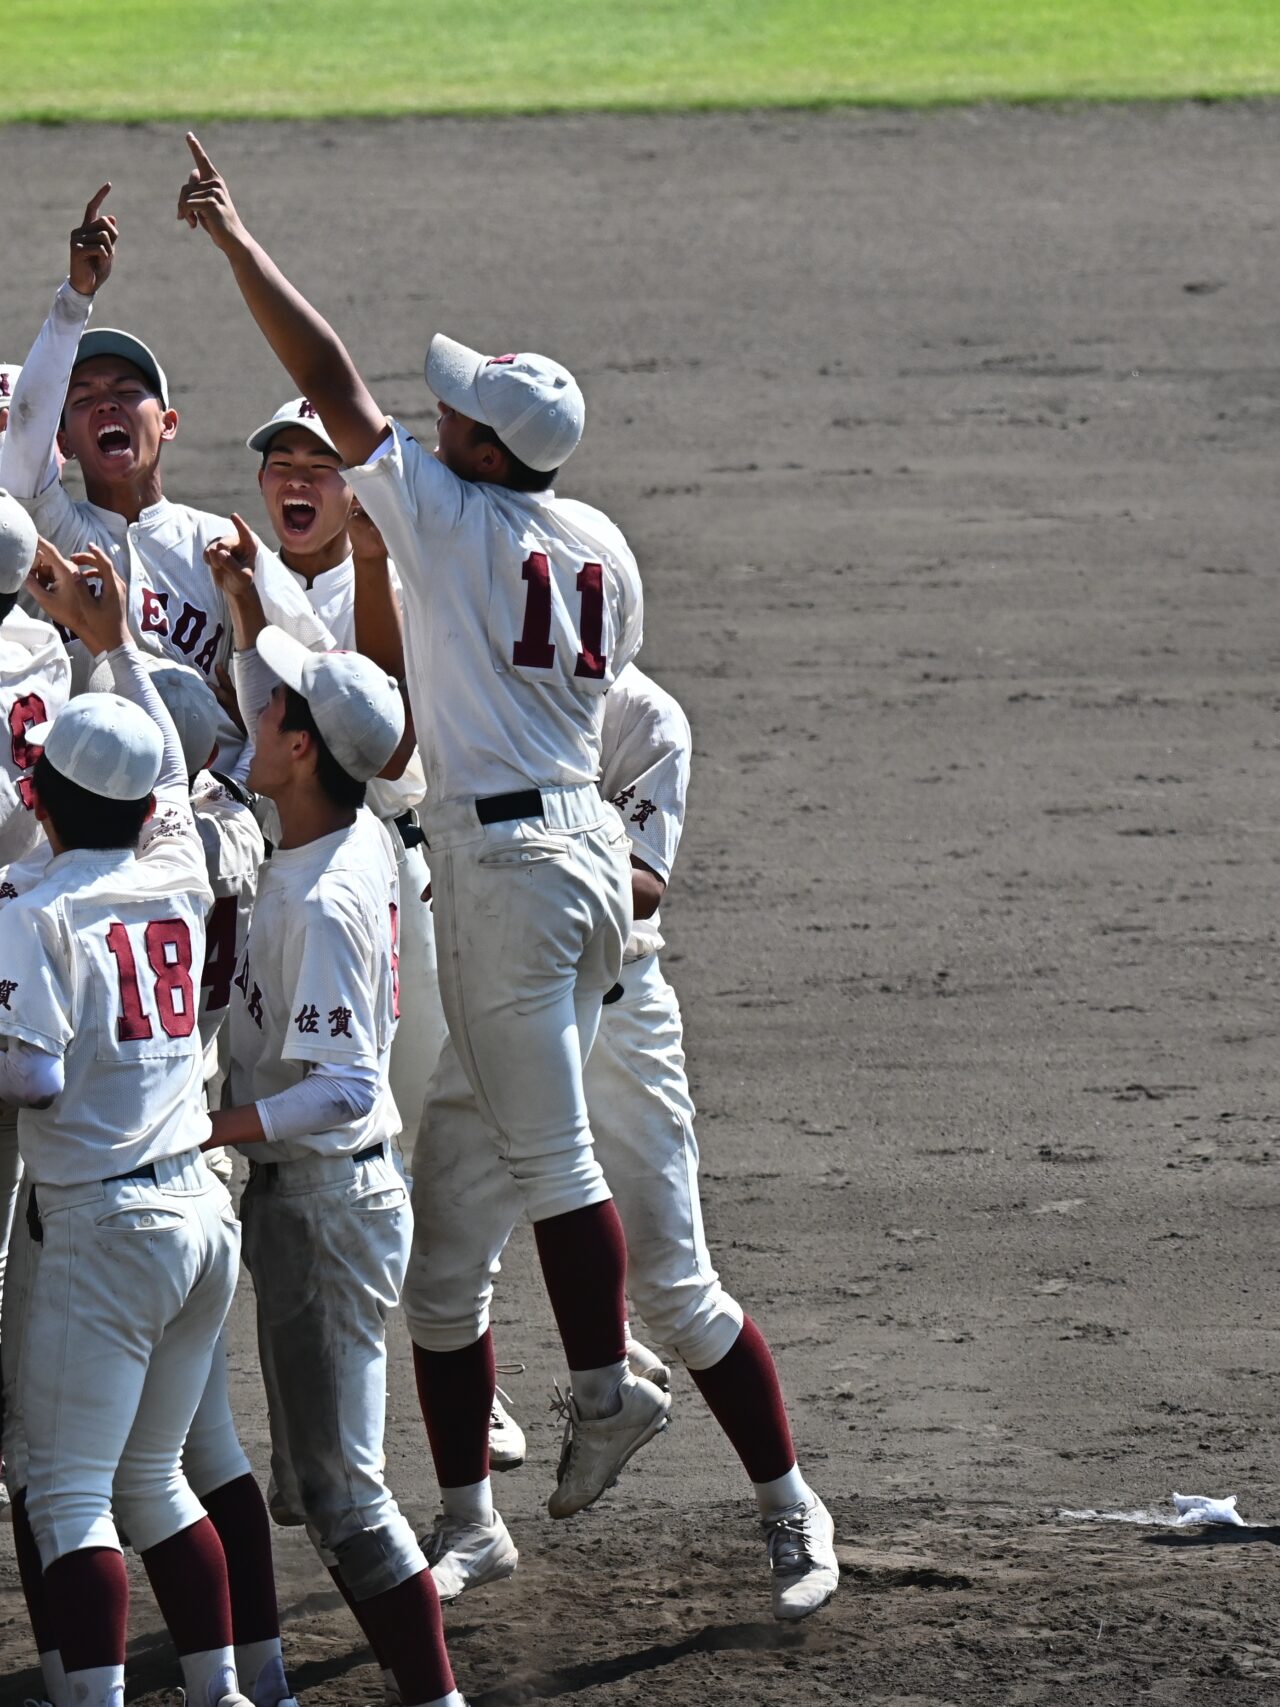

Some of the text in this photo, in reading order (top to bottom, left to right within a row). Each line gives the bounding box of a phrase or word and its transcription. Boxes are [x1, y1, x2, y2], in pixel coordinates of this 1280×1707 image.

[513, 551, 607, 680] 11
[106, 918, 195, 1041] 18
[295, 1004, 352, 1039] 佐賀
